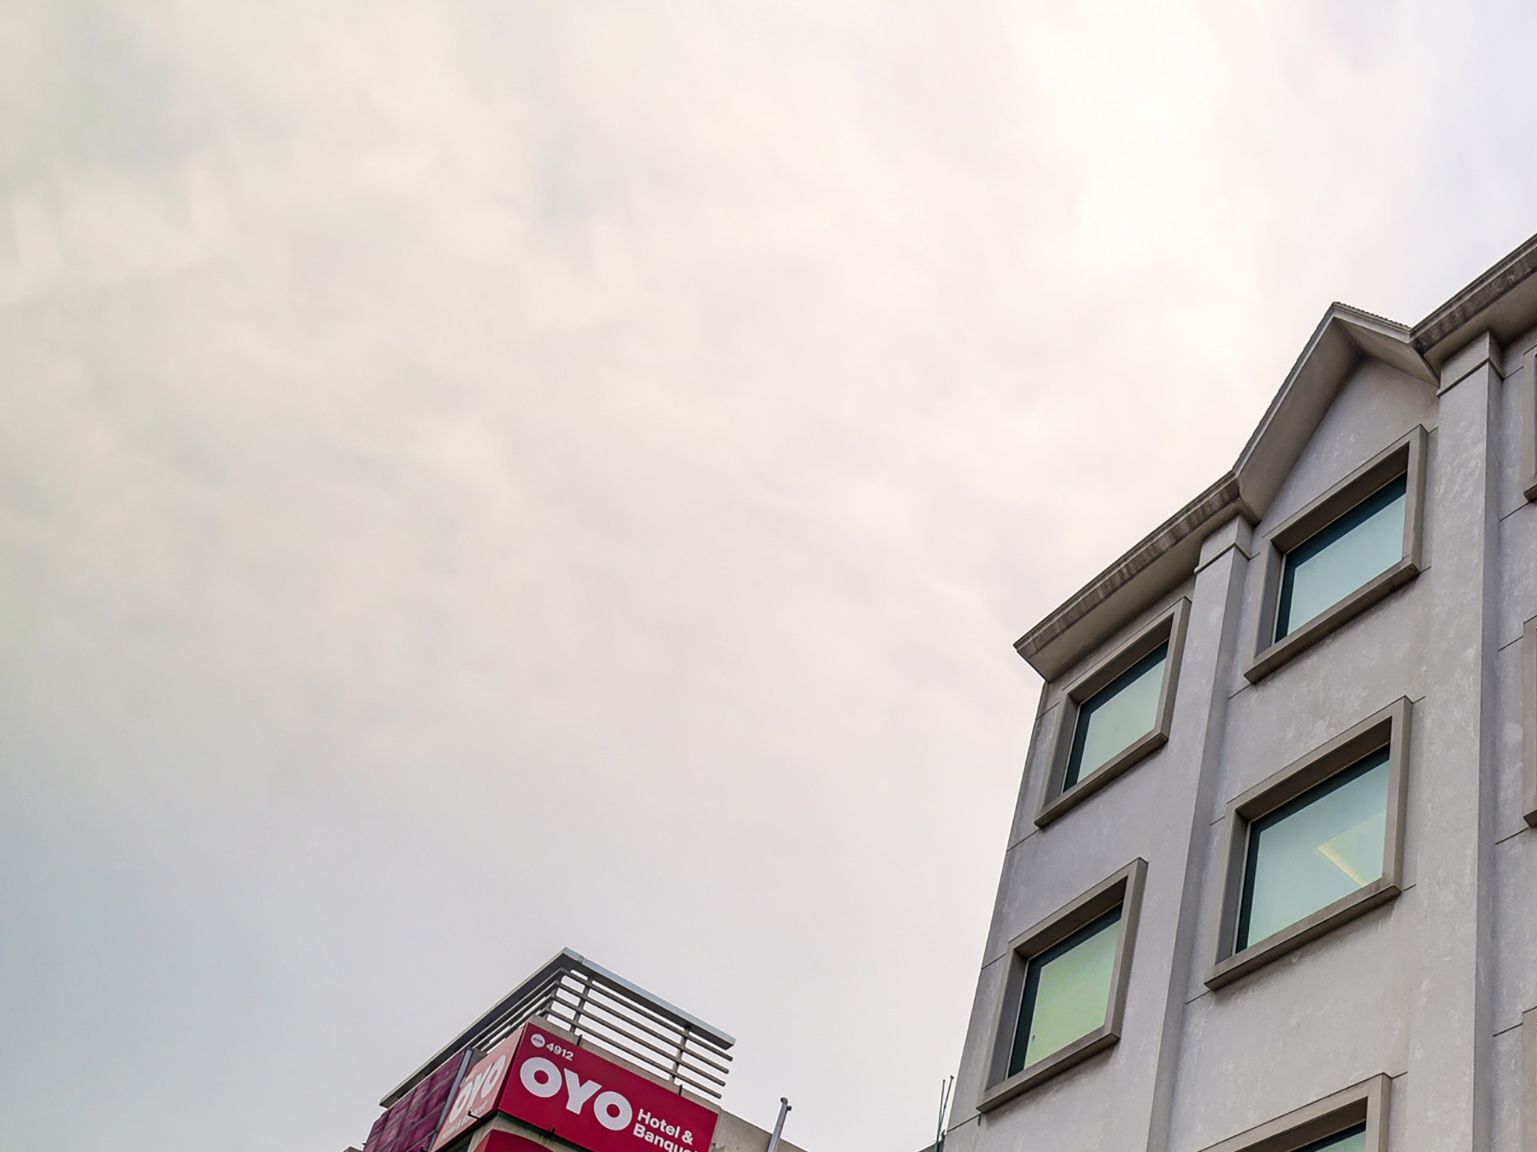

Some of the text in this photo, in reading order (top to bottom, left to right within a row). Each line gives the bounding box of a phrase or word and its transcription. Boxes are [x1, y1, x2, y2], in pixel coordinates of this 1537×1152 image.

[545, 1042, 574, 1062] 4912
[450, 1055, 506, 1123] OYO
[519, 1056, 633, 1132] OYO
[637, 1108, 694, 1146] Hotel &
